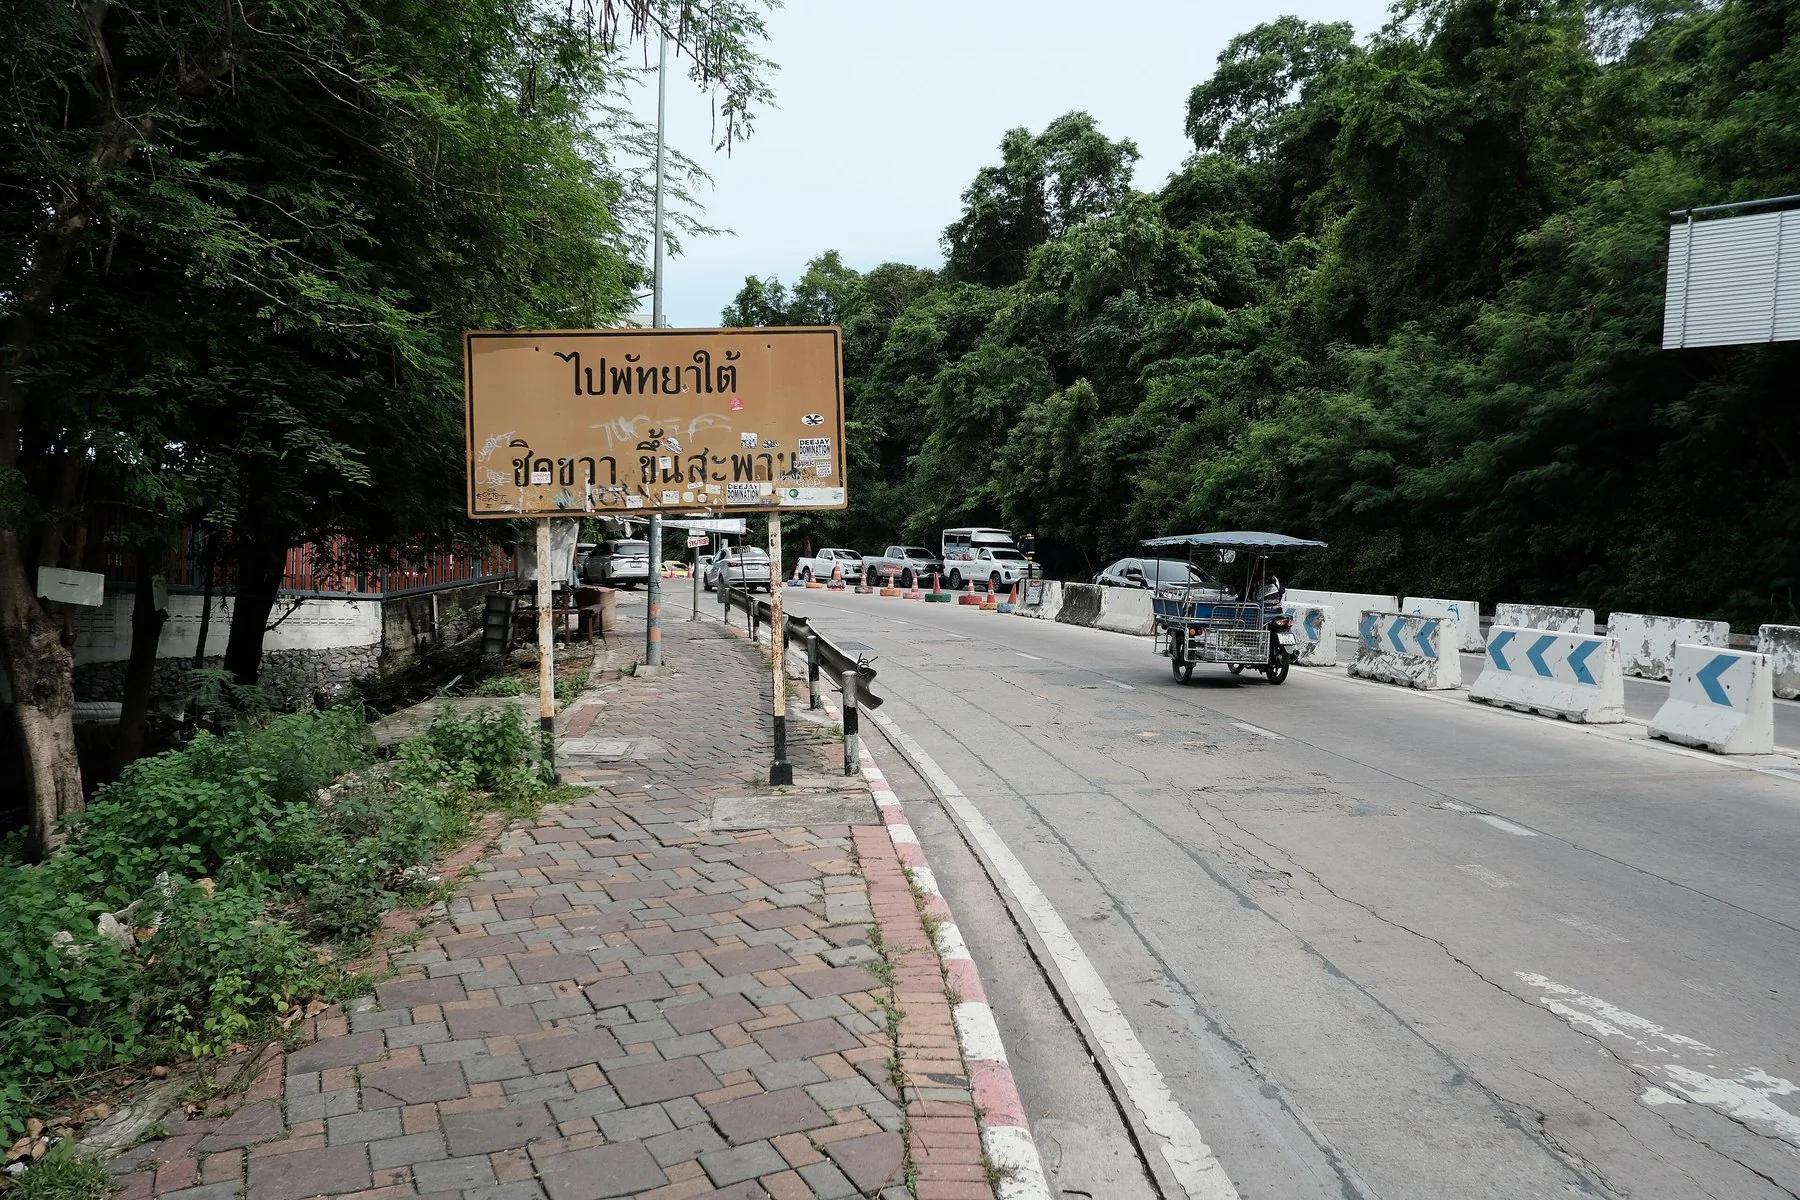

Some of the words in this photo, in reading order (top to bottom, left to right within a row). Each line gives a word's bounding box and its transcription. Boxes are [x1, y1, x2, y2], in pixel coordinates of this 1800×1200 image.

[553, 349, 741, 396] ไปพัทยาใต้
[509, 438, 616, 487] ชิดขวา
[799, 445, 831, 455] DOMINATION
[727, 489, 759, 499] DOMINATION
